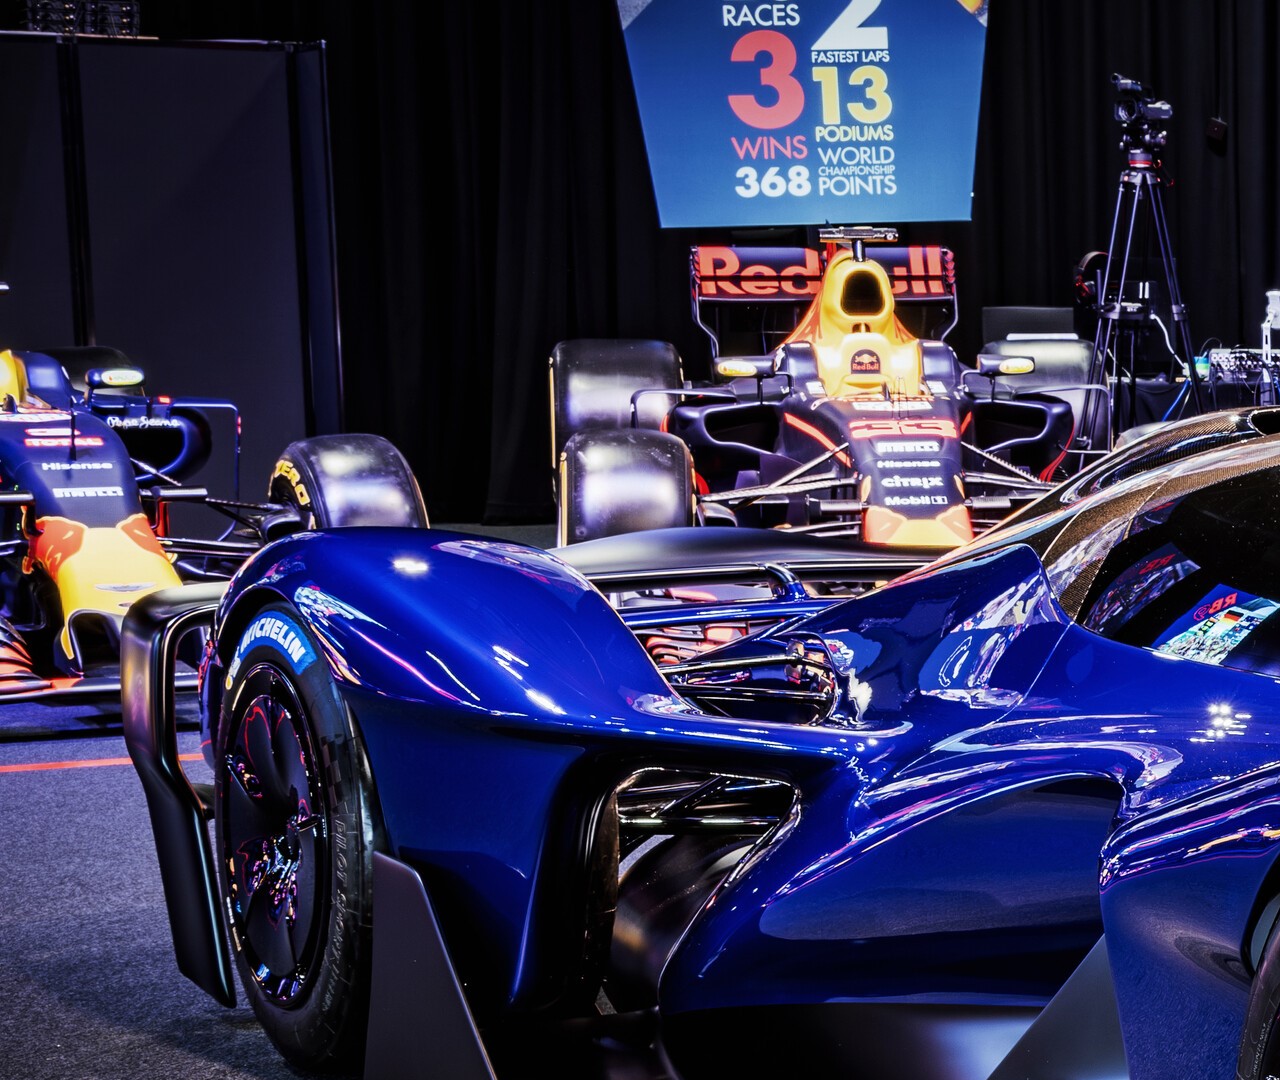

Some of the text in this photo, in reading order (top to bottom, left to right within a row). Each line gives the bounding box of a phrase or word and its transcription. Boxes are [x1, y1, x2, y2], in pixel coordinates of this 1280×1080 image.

[722, 4, 800, 27] RACES
[811, 50, 890, 64] FASTEST LAPS
[727, 29, 805, 130] 3
[811, 65, 893, 125] 13
[815, 124, 894, 142] PODIUMS
[730, 135, 808, 161] WINS
[817, 146, 895, 165] WORLD
[818, 164, 896, 176] CHAMPIONSHIP
[735, 166, 812, 198] 368
[818, 175, 897, 197] POINTS
[700, 246, 821, 294] Red
[848, 419, 959, 439] 33
[42, 462, 113, 471] Hisense
[883, 496, 931, 506] Mobil
[240, 616, 306, 664] MICHELIN
